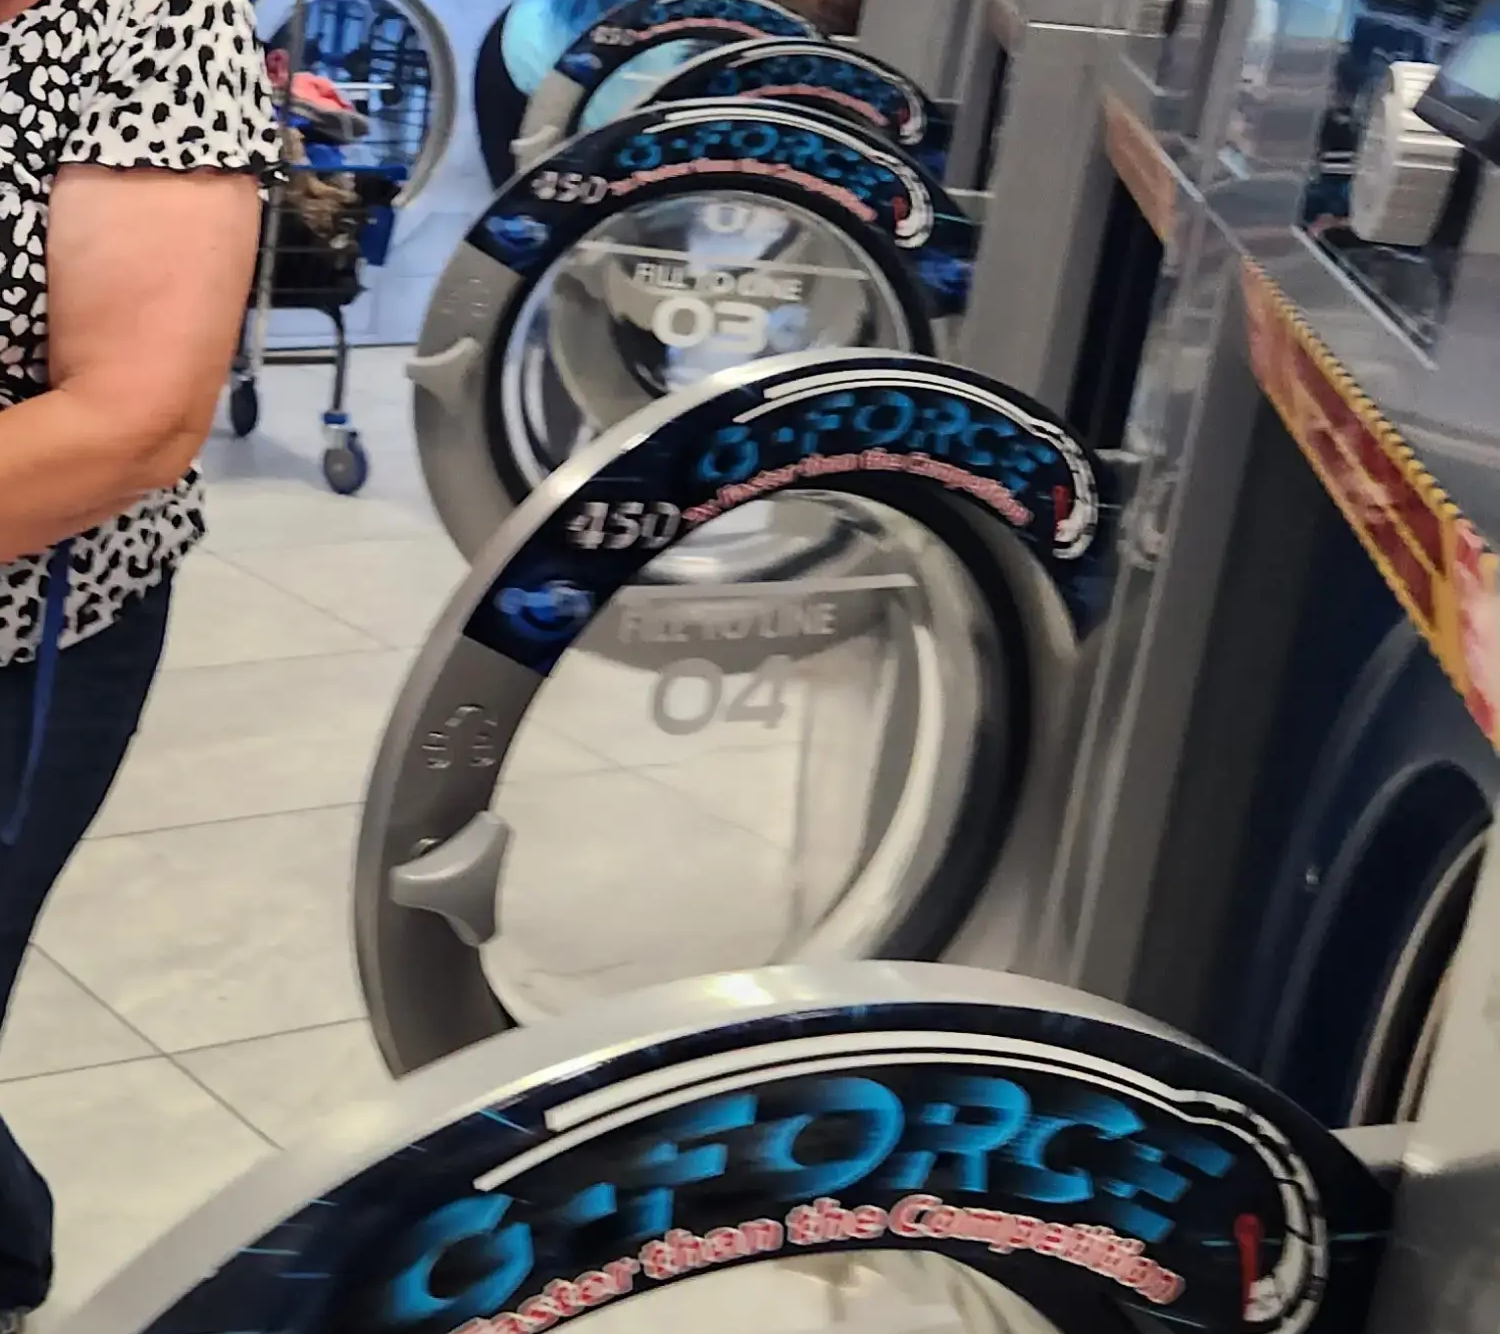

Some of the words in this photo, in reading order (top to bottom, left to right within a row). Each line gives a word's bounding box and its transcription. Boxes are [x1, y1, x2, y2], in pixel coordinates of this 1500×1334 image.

[566, 499, 681, 550] 450
[651, 653, 786, 736] 04
[638, 1217, 785, 1281] than
[785, 1196, 890, 1246] the
